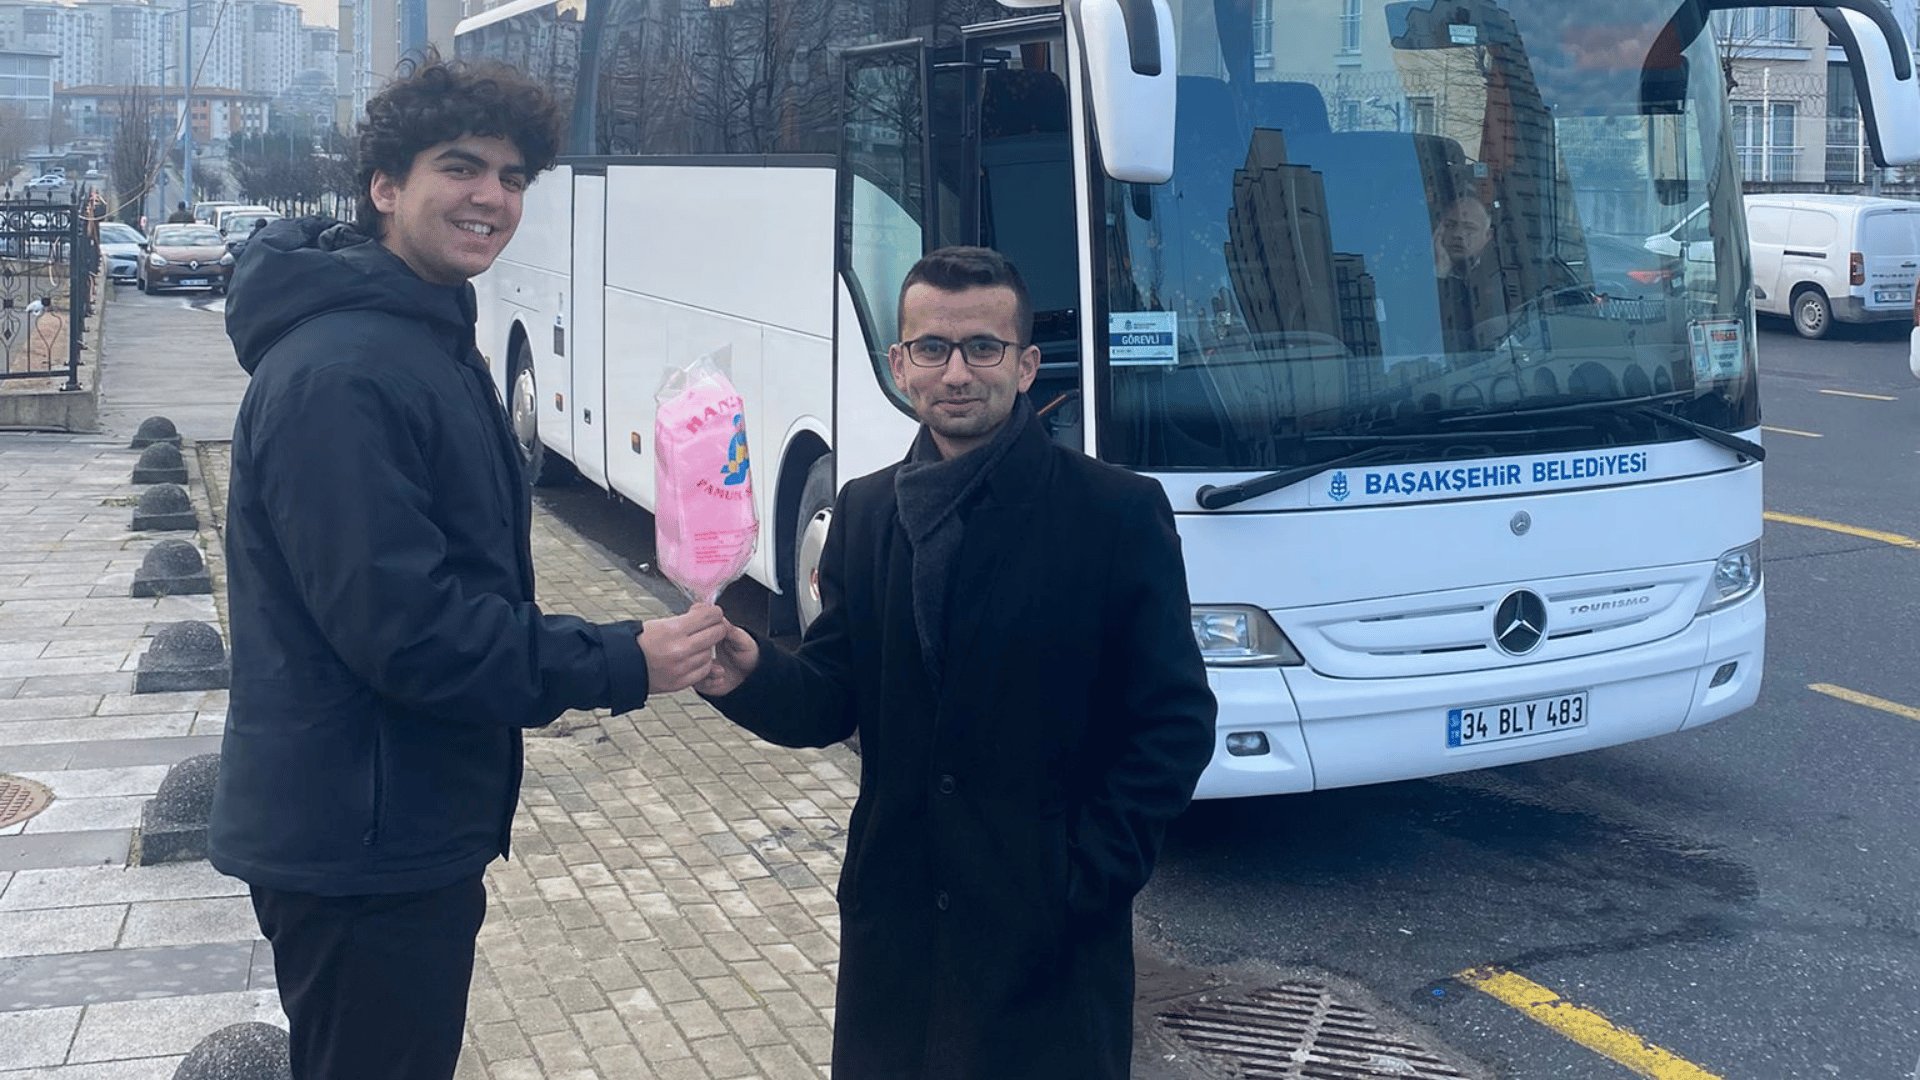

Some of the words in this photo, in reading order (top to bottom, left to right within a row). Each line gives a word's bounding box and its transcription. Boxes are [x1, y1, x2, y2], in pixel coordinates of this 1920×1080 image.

[1569, 596, 1650, 614] TOURISMO
[1463, 712, 1488, 739] 34
[1499, 704, 1537, 734] BLY
[1547, 696, 1583, 726] 483
